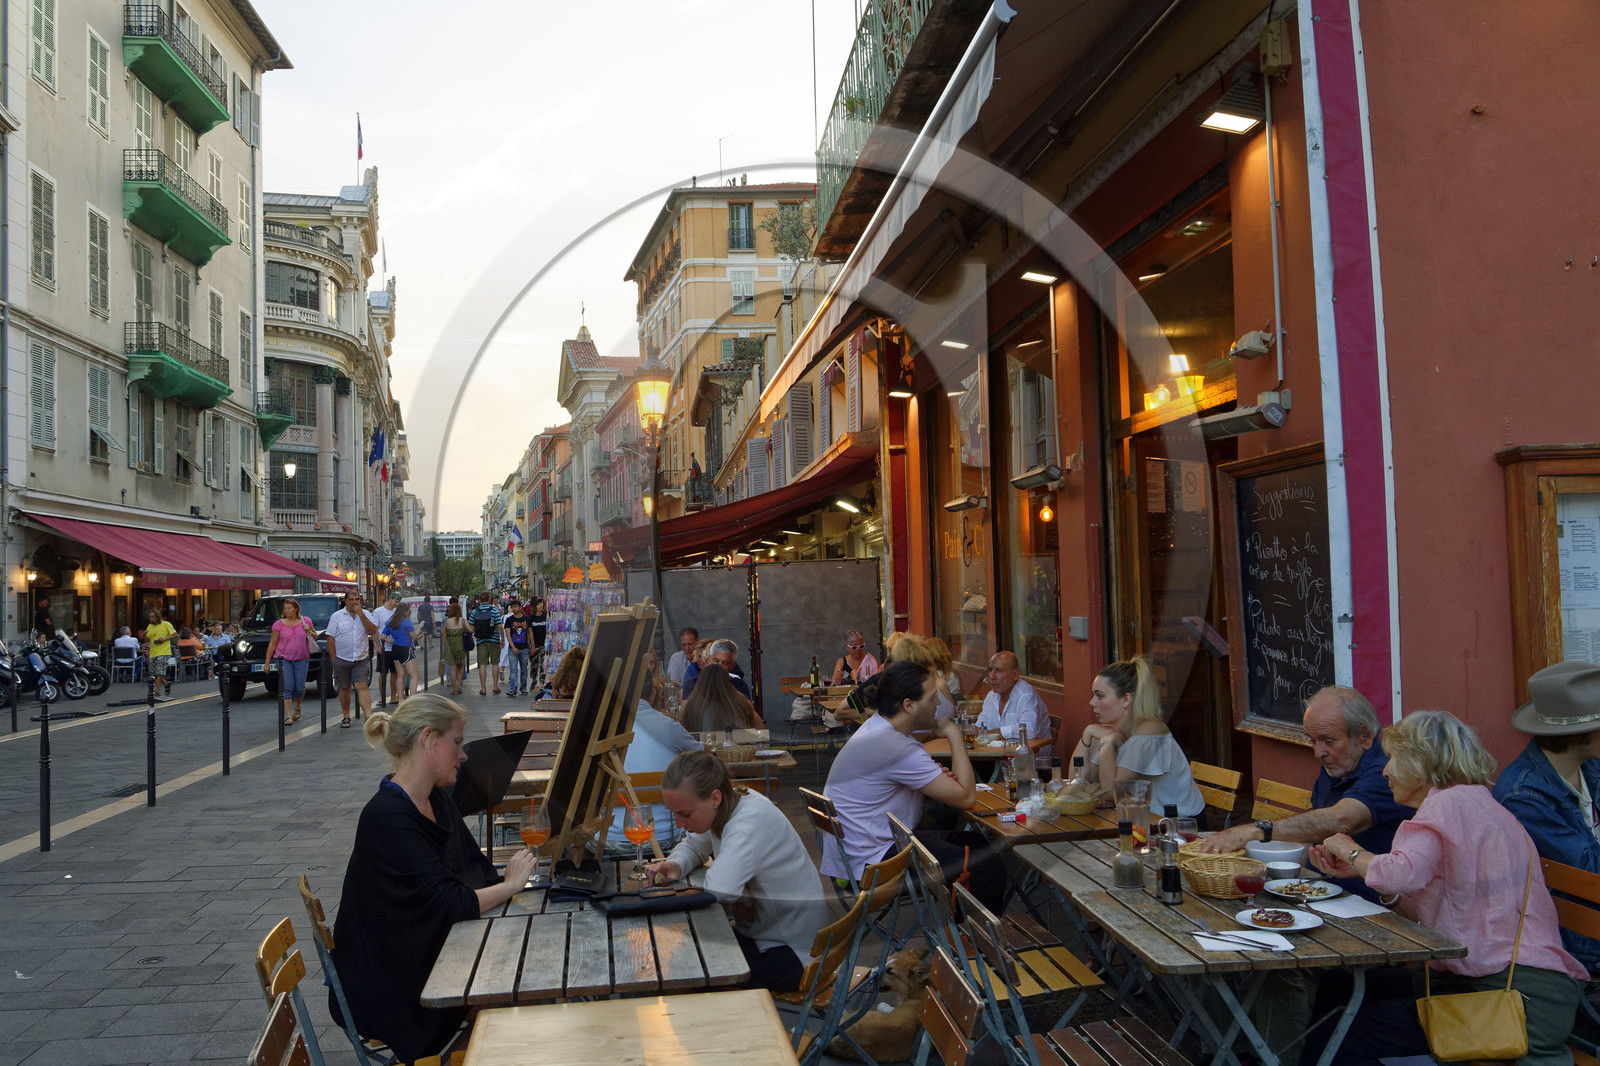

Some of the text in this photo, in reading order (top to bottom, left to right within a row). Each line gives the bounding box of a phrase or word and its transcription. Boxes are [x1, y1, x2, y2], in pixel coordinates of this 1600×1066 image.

[1253, 477, 1314, 520] Suggestions
[944, 529, 961, 559] Pain
[962, 516, 974, 567] &
